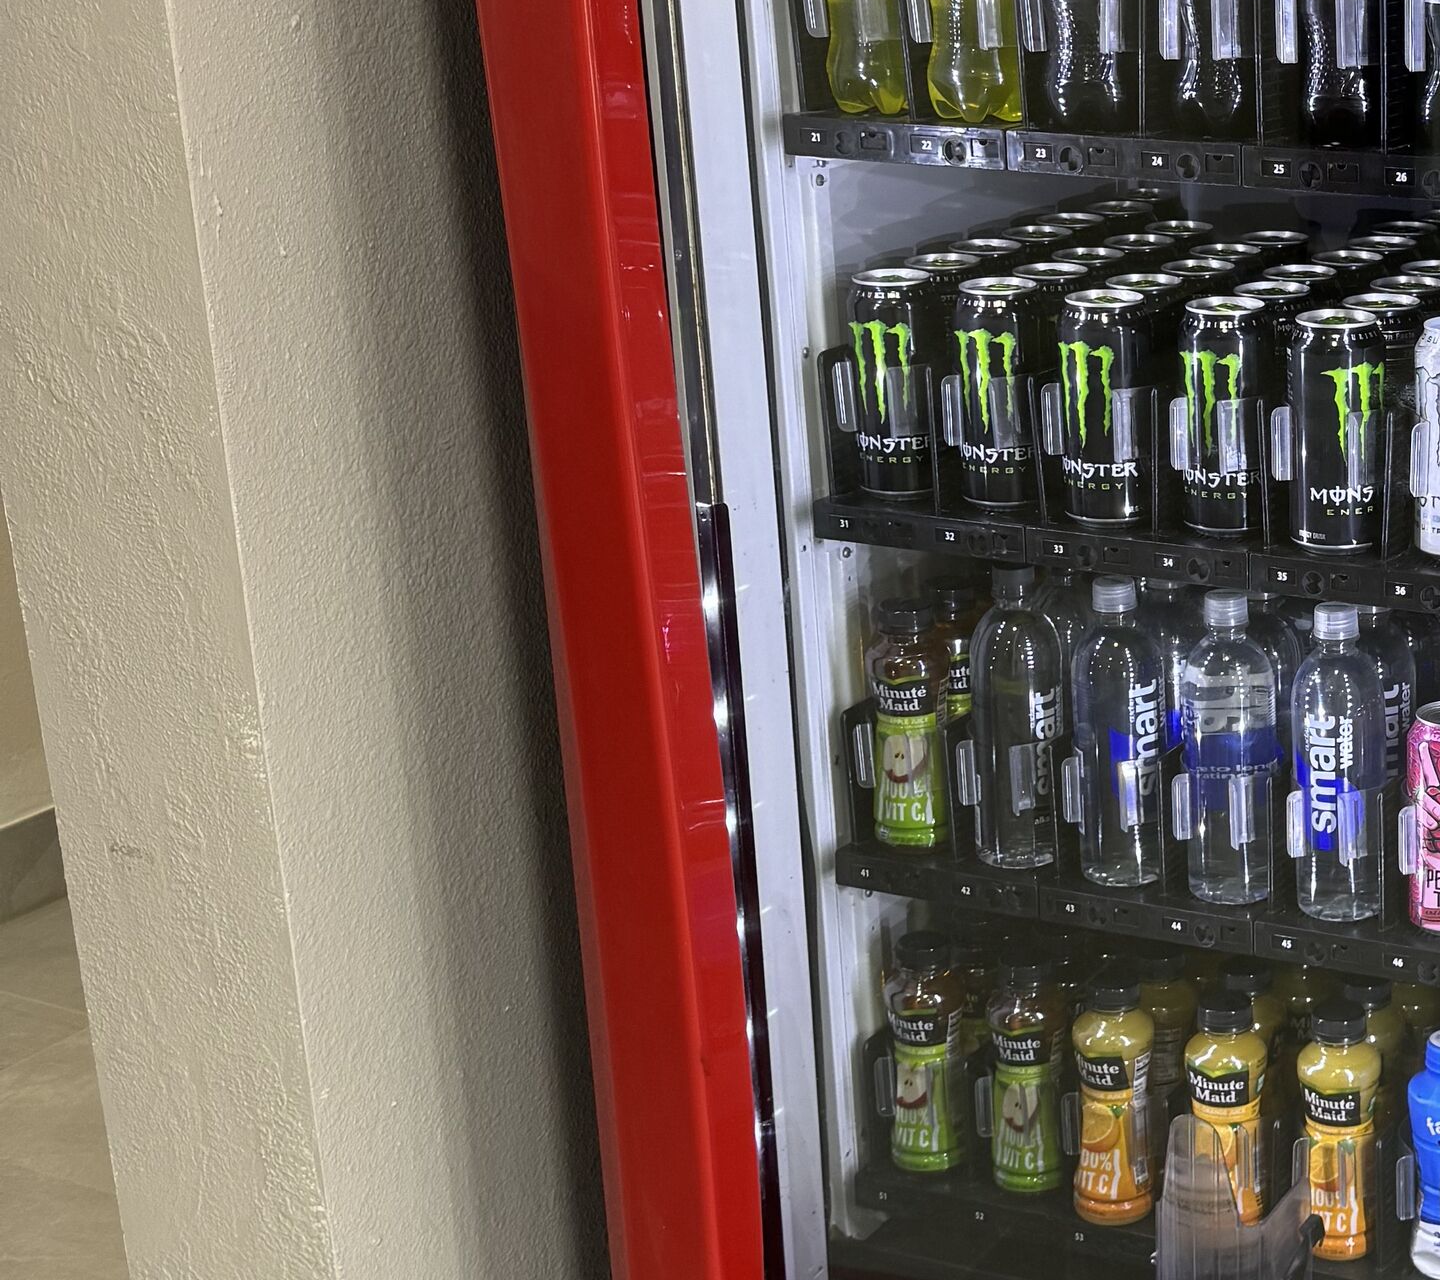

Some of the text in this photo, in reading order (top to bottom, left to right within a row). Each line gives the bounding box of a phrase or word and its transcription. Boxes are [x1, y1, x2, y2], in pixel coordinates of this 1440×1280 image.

[811, 132, 821, 142] 21
[921, 140, 933, 150] 22
[1035, 148, 1047, 159] 23
[1151, 155, 1163, 166] 24
[1273, 164, 1285, 175] 25
[1395, 172, 1408, 183] 26
[859, 452, 924, 464] ENERGY
[962, 462, 1026, 475] ENERGY
[1064, 475, 1124, 490] ENERGY
[1184, 485, 1248, 500] ENERGY
[1310, 484, 1375, 507] MONS
[1326, 505, 1374, 516] ENER
[839, 519, 849, 528] 31
[944, 531, 955, 541] 32
[1053, 544, 1064, 554] 33
[1162, 558, 1174, 568] 34
[1276, 571, 1288, 582] 35
[1394, 585, 1407, 596] 36
[872, 681, 927, 699] Minute
[879, 697, 920, 711] Maid
[1309, 712, 1353, 834] smart water
[885, 801, 907, 822] VIT
[860, 868, 870, 878] 41
[960, 886, 971, 896] 42
[1065, 903, 1075, 913] 43
[1171, 922, 1182, 932] 44
[1281, 939, 1292, 950] 45
[1392, 957, 1404, 968] 46
[887, 1009, 934, 1032] Minute
[893, 1027, 928, 1042] Maid
[992, 1032, 1041, 1050] Minute
[999, 1047, 1035, 1062] Maid
[1189, 1070, 1245, 1091] Minute
[1195, 1086, 1237, 1104] Maid
[1304, 1087, 1355, 1110] Minute
[1310, 1104, 1347, 1122] Maid
[919, 1129, 930, 1148] C
[1024, 1152, 1034, 1170] C
[1098, 1174, 1109, 1194] C
[879, 1191, 888, 1200] 51
[975, 1211, 985, 1221] 52
[1074, 1232, 1084, 1242] 53
